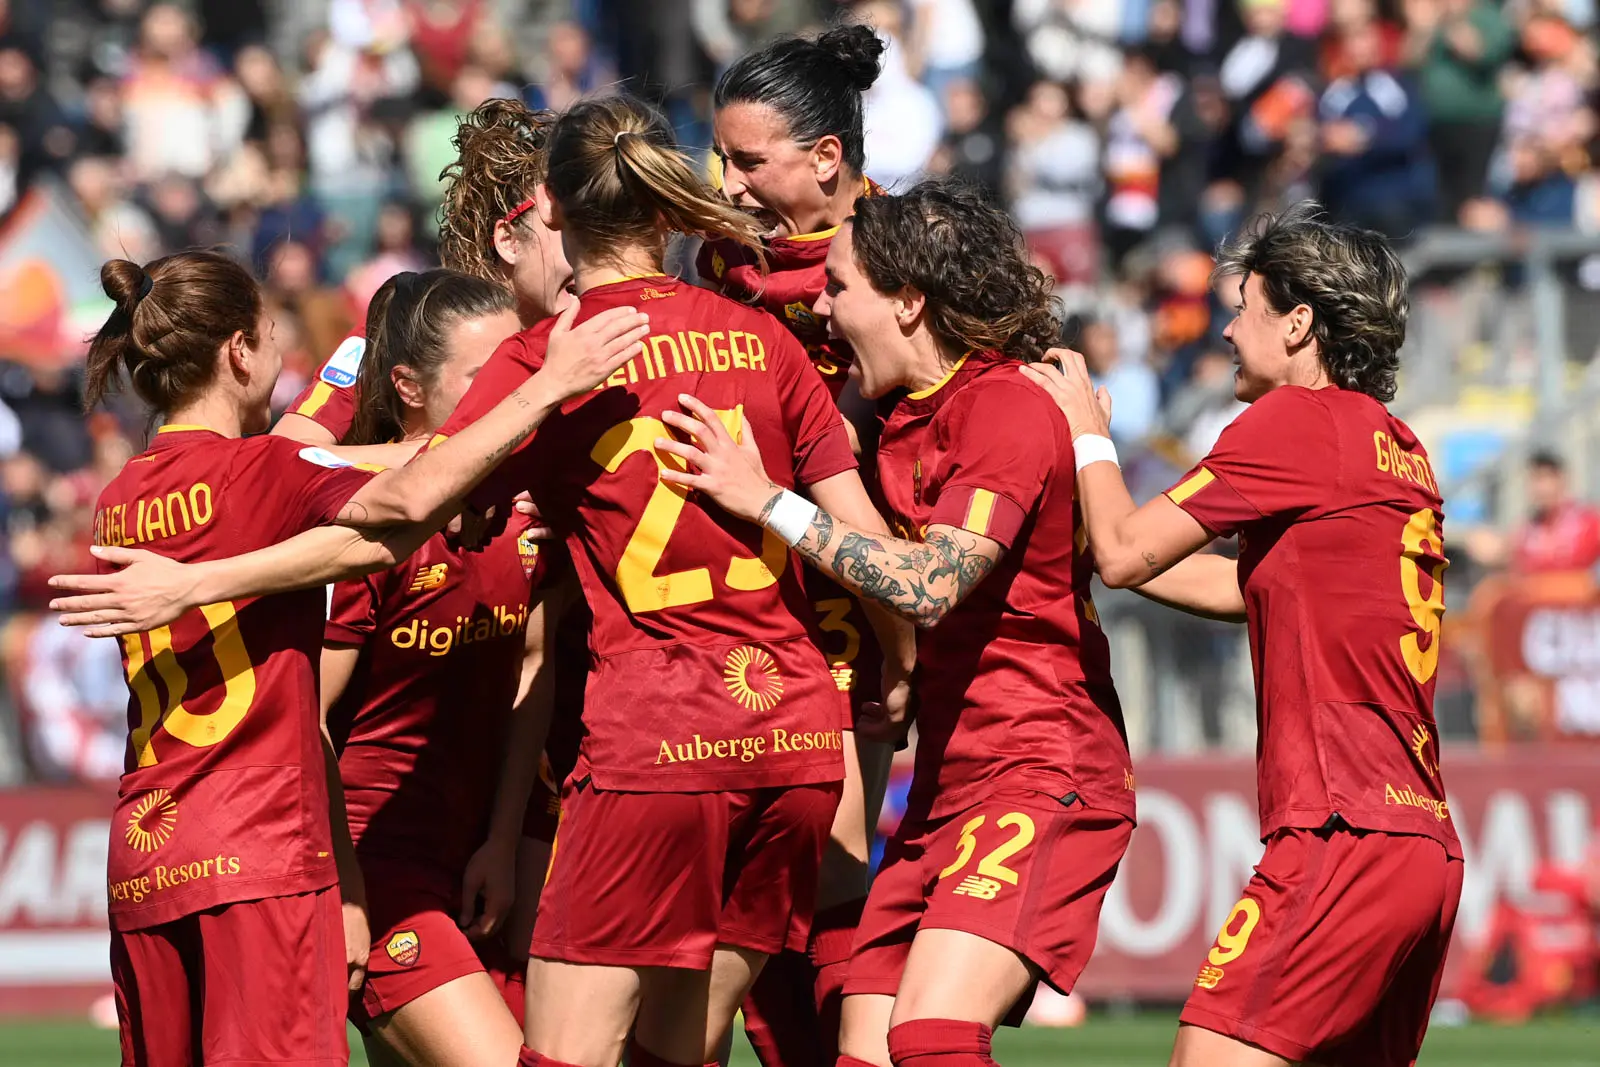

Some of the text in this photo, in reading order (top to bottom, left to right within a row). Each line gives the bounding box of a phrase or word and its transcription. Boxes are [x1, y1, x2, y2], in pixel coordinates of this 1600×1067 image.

[334, 371, 352, 383] TIM
[594, 330, 767, 391] ENNINGER
[1400, 507, 1450, 685] 9
[119, 601, 257, 767] 10
[654, 728, 842, 764] Auberge Resorts
[1385, 783, 1449, 822] Auberge
[154, 854, 241, 890] Resorts
[939, 811, 1036, 886] 32
[1208, 897, 1260, 966] 9
